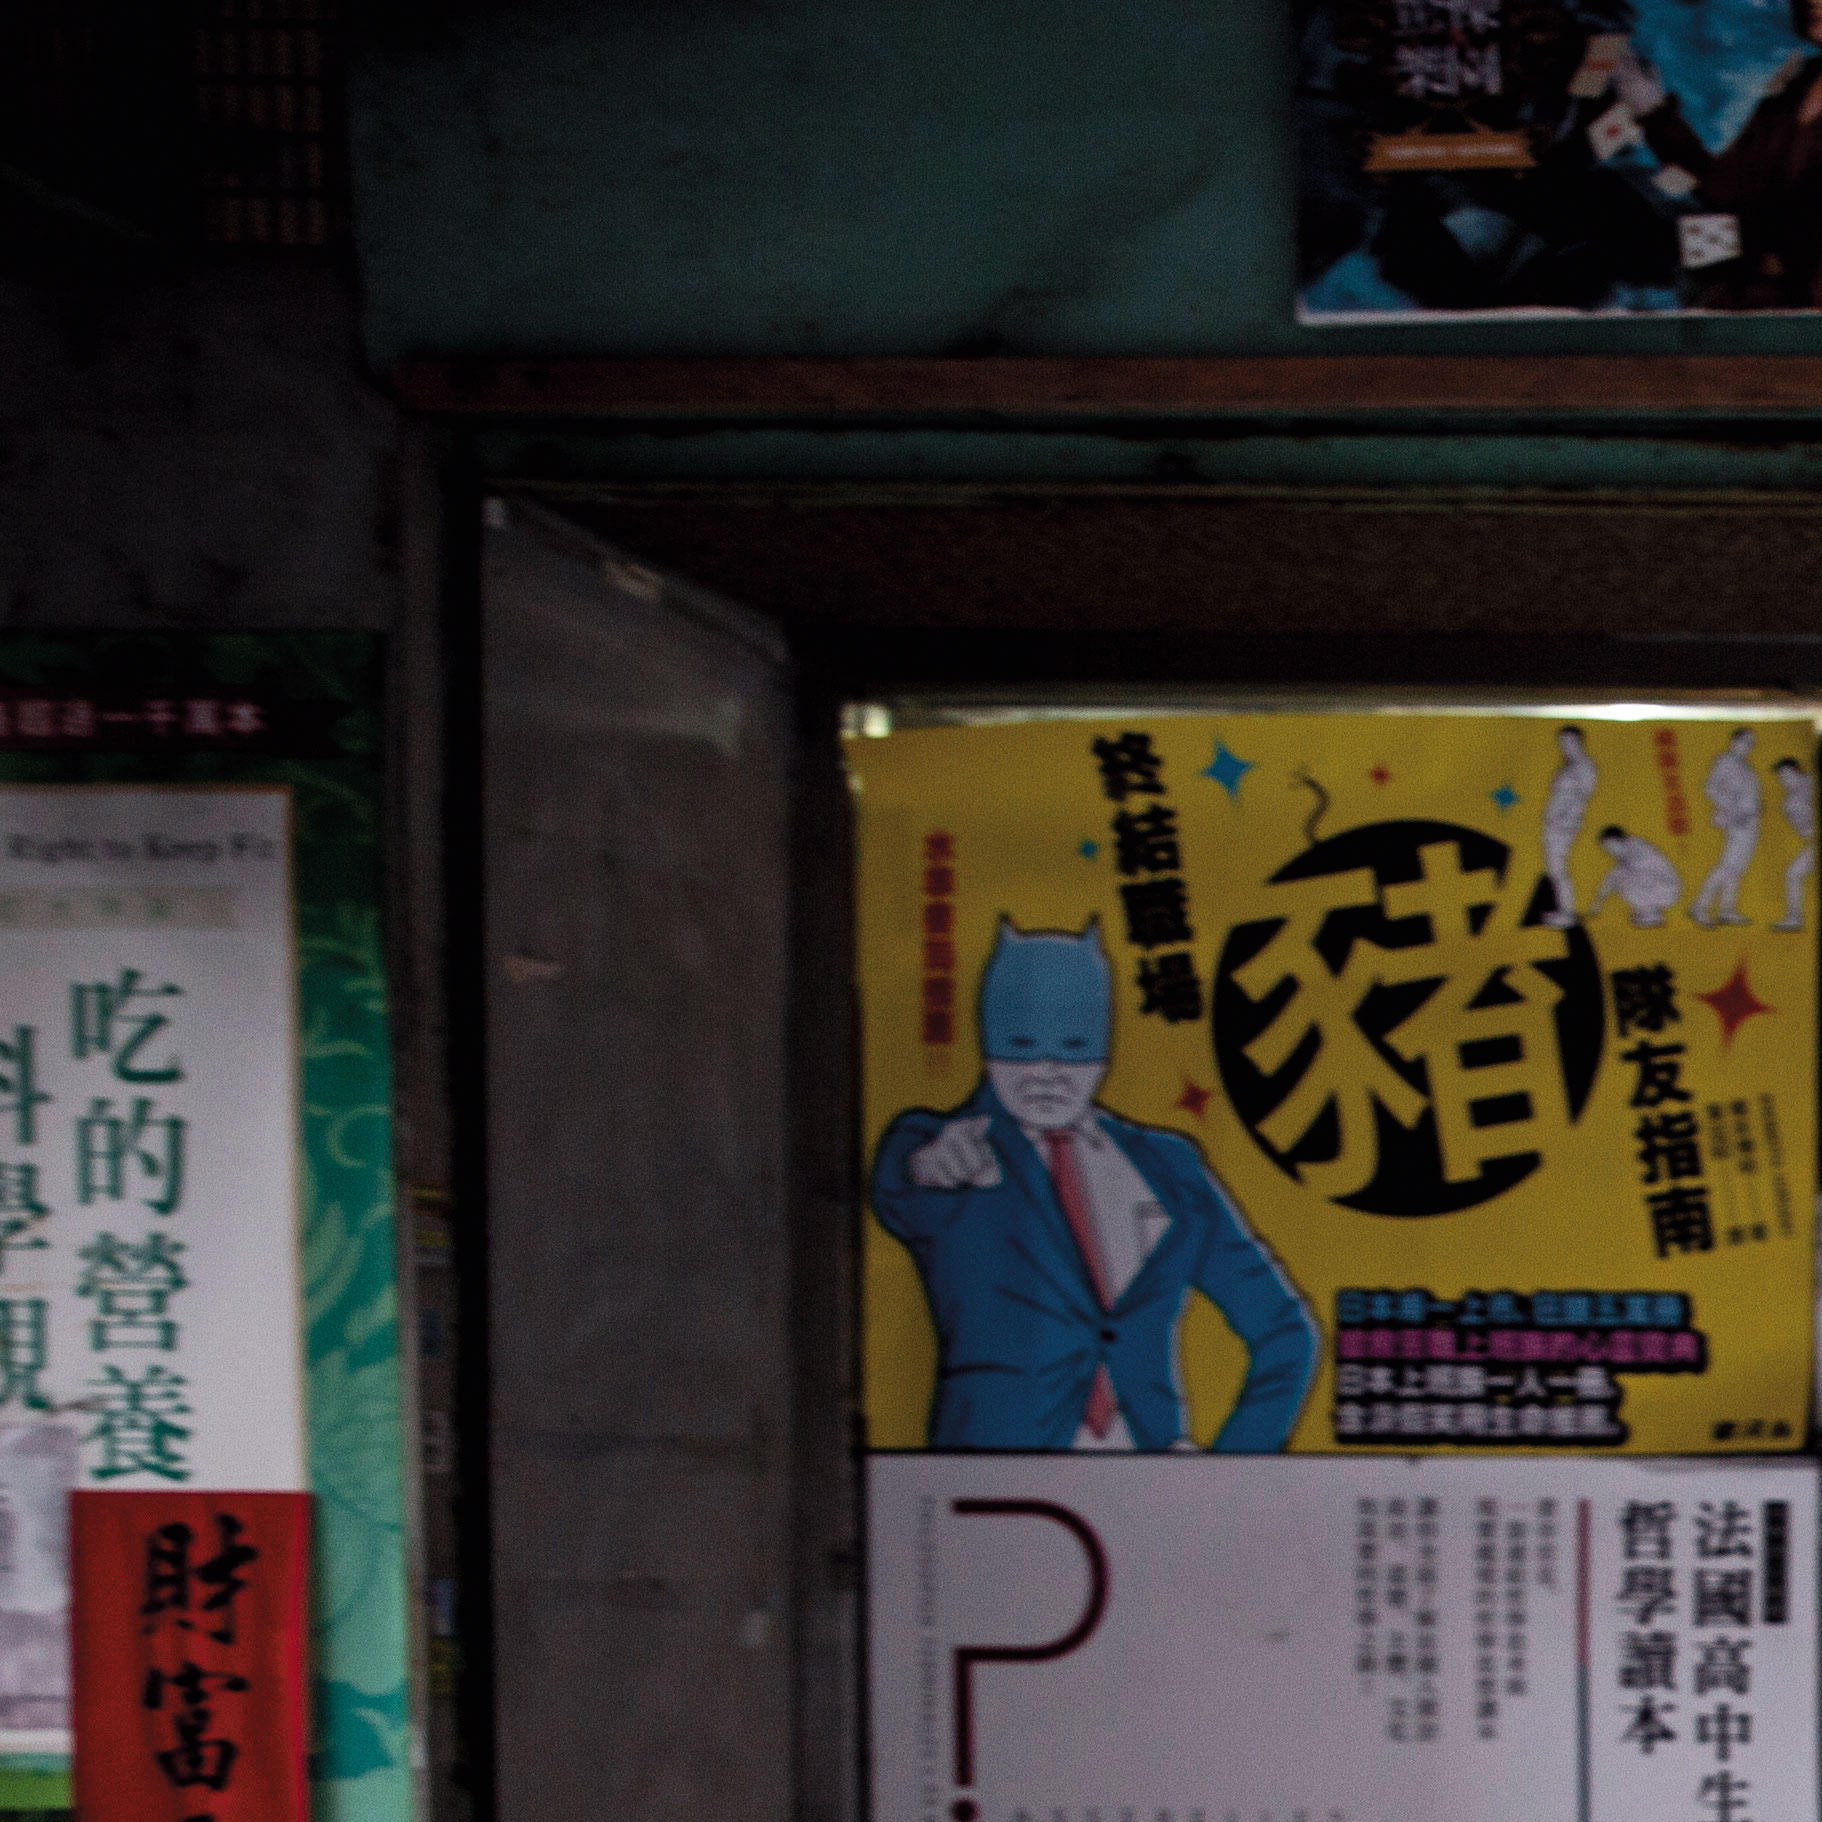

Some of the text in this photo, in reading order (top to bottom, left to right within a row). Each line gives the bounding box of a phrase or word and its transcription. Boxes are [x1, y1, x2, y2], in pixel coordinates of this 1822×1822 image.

[1231, 838, 1568, 1198] 豬
[1610, 962, 1716, 1262] 隊友指南
[68, 967, 192, 1483] 吃的營養
[1616, 1500, 1680, 1756] 哲學讀本
